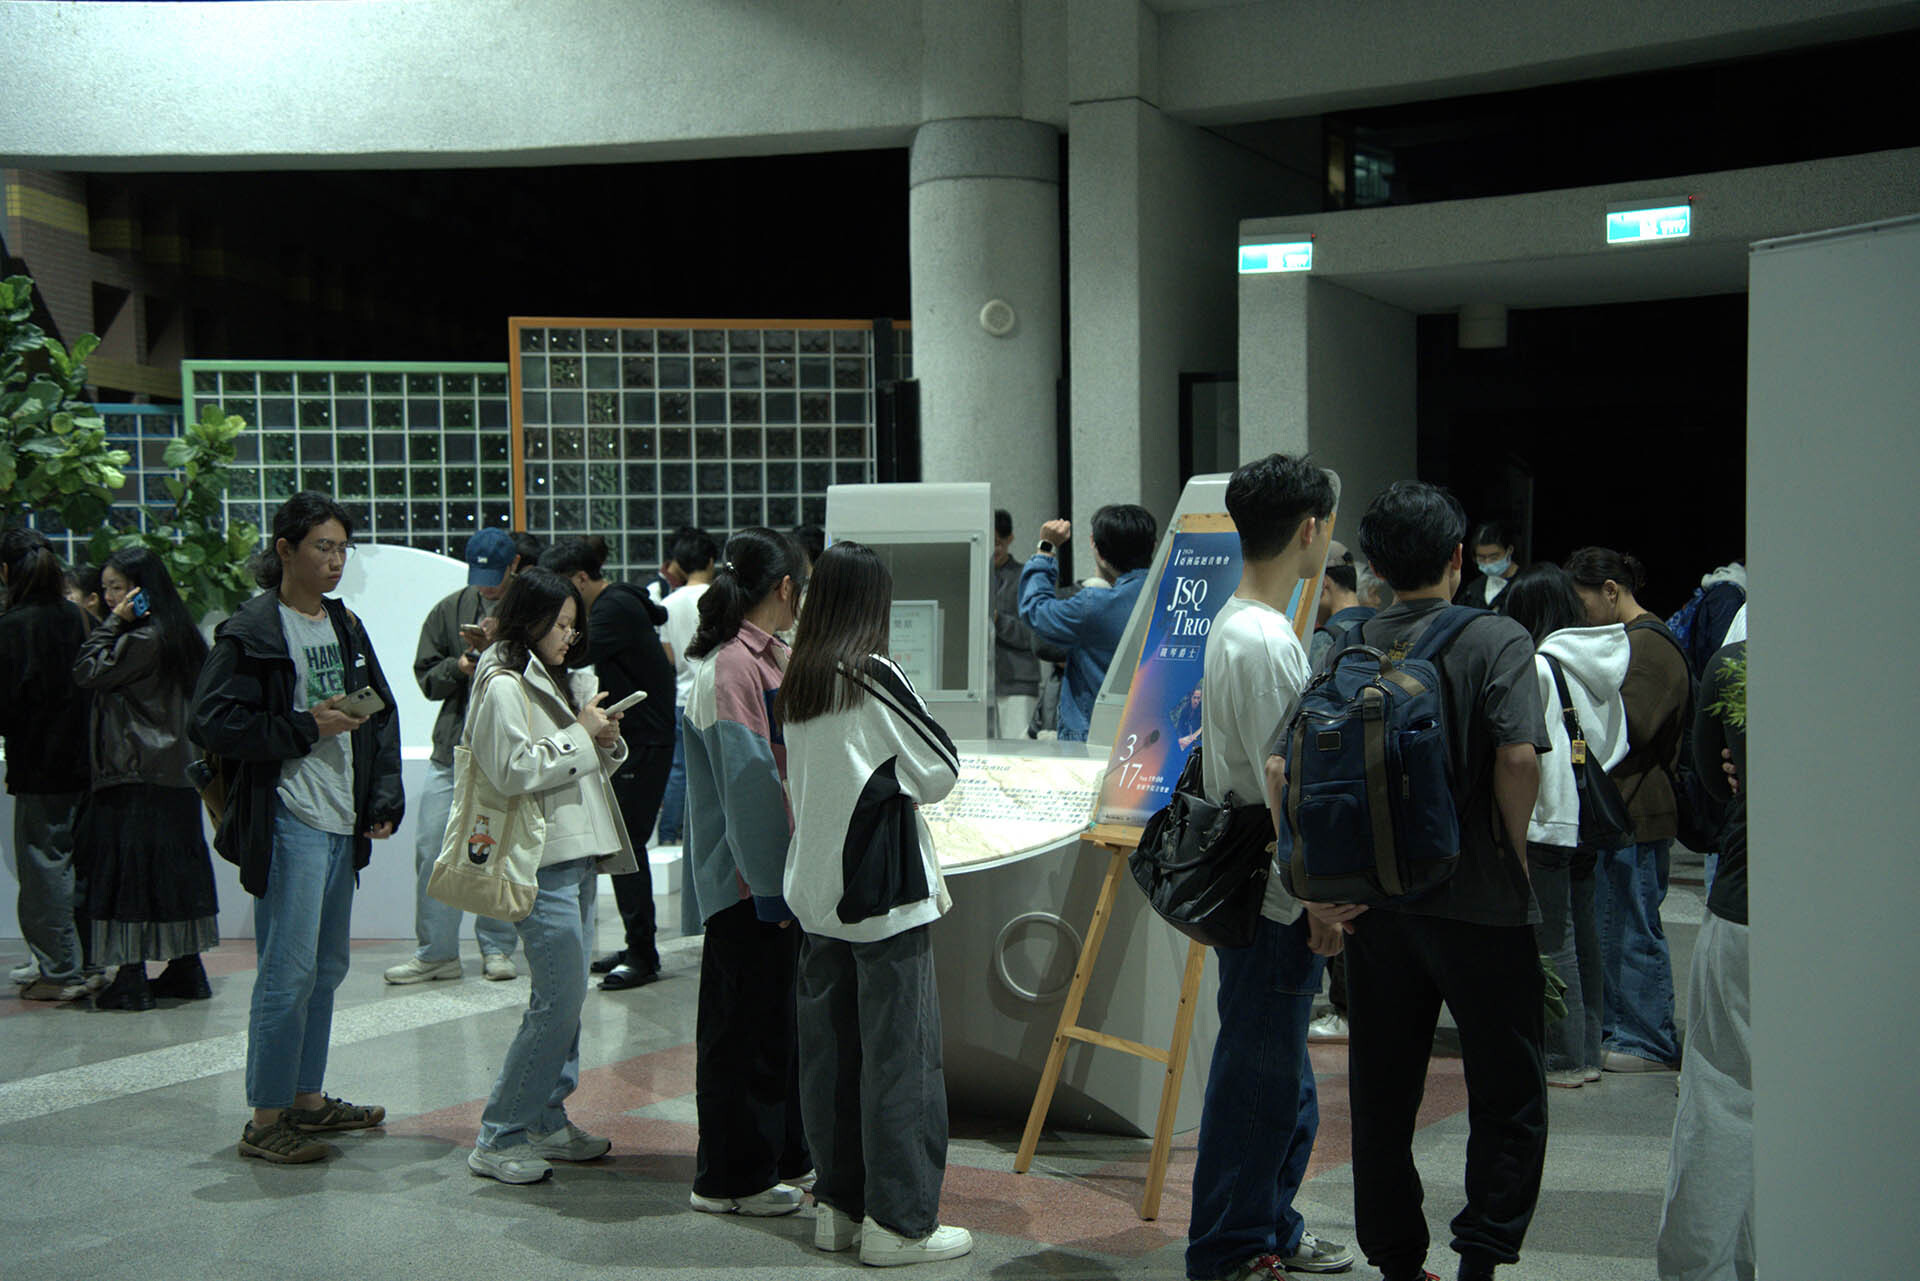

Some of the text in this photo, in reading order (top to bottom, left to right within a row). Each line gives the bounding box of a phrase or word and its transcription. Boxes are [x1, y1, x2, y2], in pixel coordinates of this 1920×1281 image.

[1167, 576, 1208, 611] JSQ
[305, 643, 341, 670] HAN
[1119, 734, 1137, 761] 3
[1119, 763, 1143, 789] 17
